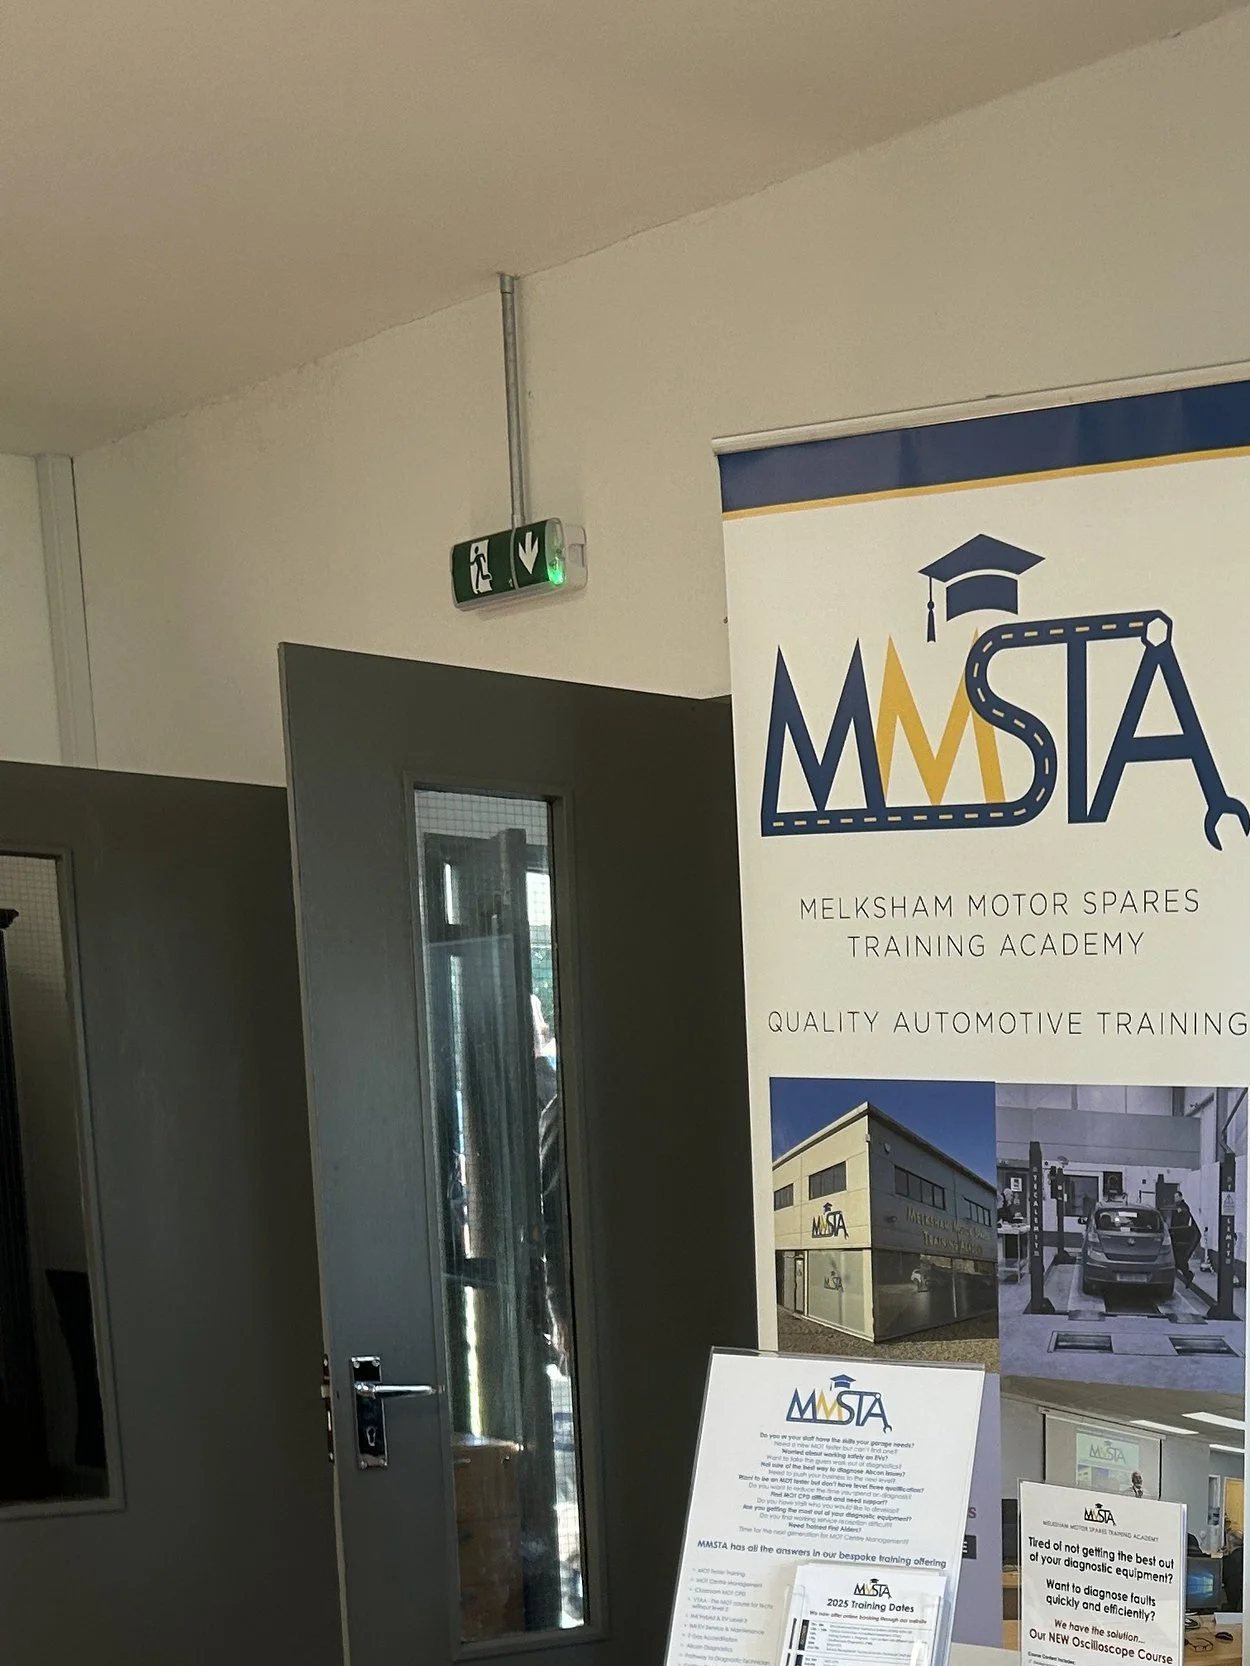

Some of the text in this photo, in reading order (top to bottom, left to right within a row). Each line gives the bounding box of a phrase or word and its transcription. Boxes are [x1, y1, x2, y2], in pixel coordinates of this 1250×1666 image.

[761, 611, 1250, 851] MMSTA
[800, 888, 1198, 919] MELKSHAM MOTOR SPARES
[847, 931, 1144, 957] TRAINING ACADEMY
[768, 1010, 1247, 1035] QUALITY AUTOMOTIVE TRAINING
[786, 1387, 892, 1434] MMSTA
[697, 1539, 727, 1549] MMSTA
[730, 1542, 745, 1551] has
[746, 1544, 758, 1552] all
[760, 1544, 773, 1553] the
[775, 1547, 810, 1556] answers
[812, 1548, 820, 1556] in
[838, 1550, 876, 1562] bespoke
[877, 1554, 912, 1568] training
[913, 1557, 946, 1569] offering
[1028, 1536, 1174, 1569] Tired of not getting the best out
[1029, 1551, 1173, 1583] of your diagnostic equipment?
[826, 1598, 913, 1612] 2025 Training Dates
[1046, 1578, 1155, 1606] Want to diagnose faults
[1046, 1594, 1155, 1622] quickly and efficiently?
[1054, 1618, 1144, 1643] We have the solution...
[1029, 1628, 1172, 1664] Our NEW Oscilloscope Course
